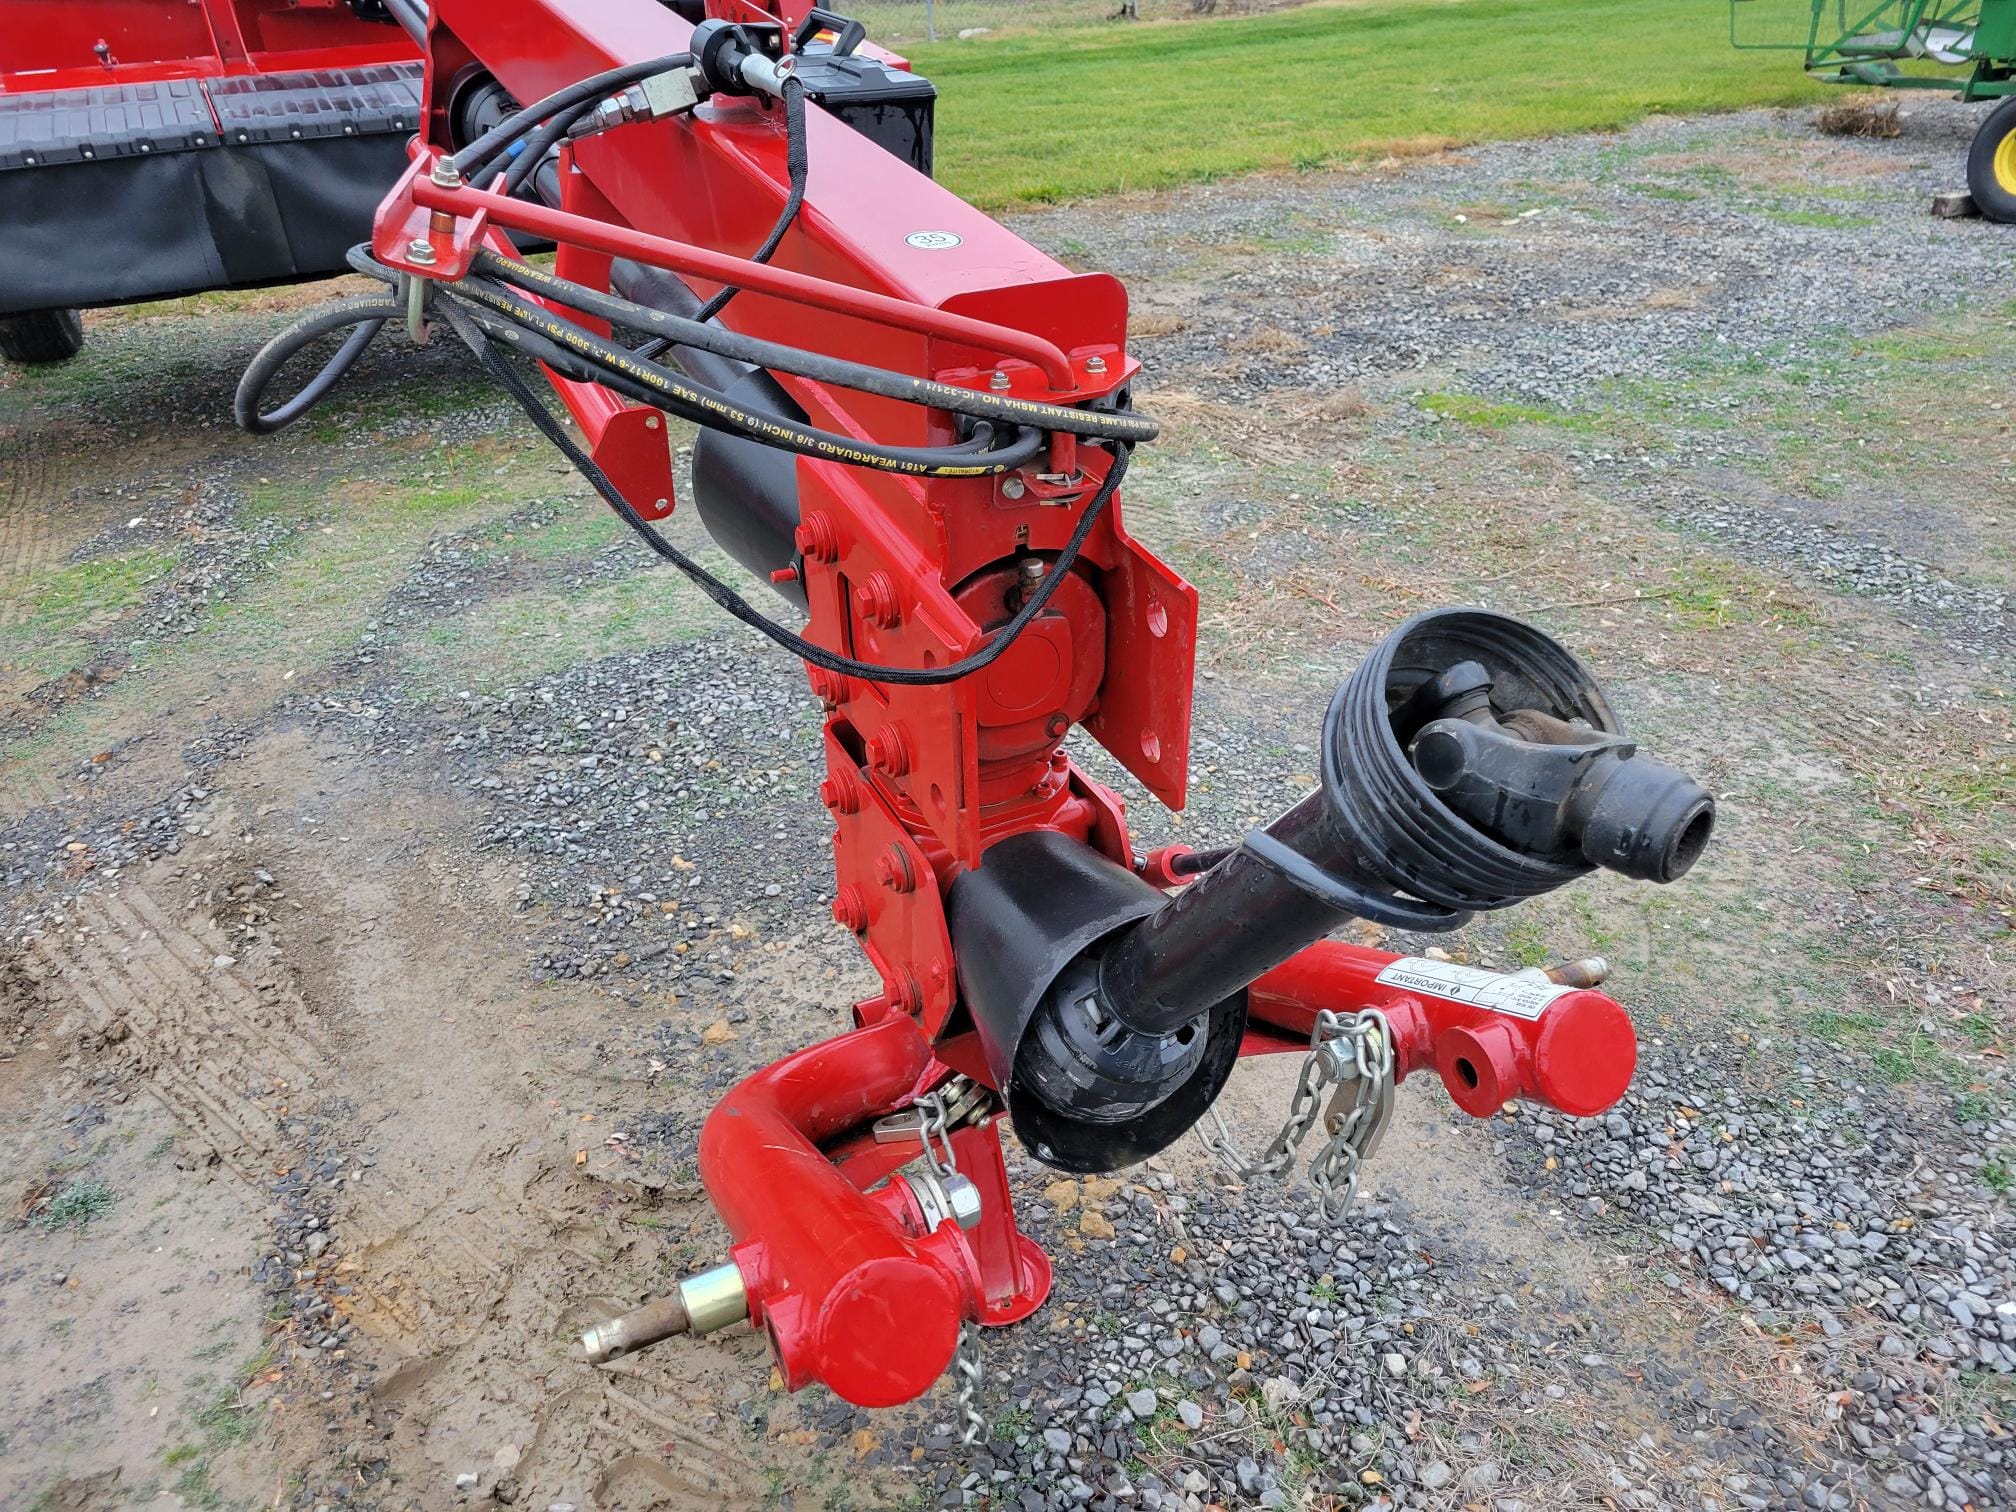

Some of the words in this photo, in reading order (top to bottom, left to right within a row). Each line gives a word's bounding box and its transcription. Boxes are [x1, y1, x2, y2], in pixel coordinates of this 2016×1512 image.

[914, 233, 947, 244] 35
[495, 257, 552, 284] WEARGUARD
[470, 286, 516, 314] RESISTANT
[547, 322, 564, 337] PSI
[566, 333, 590, 351] 3000
[619, 359, 669, 389] 100R17-6
[672, 384, 698, 402] SAE
[926, 382, 975, 400] IC-321/1
[978, 393, 1000, 405] NO.
[701, 396, 728, 414] mm)
[1004, 398, 1038, 413] MSHA
[730, 410, 760, 429] (9.53
[1040, 406, 1098, 423] RESISTANT
[1099, 416, 1127, 427] FLAME
[762, 422, 794, 440] INCH
[796, 434, 815, 447] 3/8
[818, 441, 897, 468] WEARGUARD
[901, 461, 928, 473] A151
[1390, 973, 1448, 992] IMPORTANT
